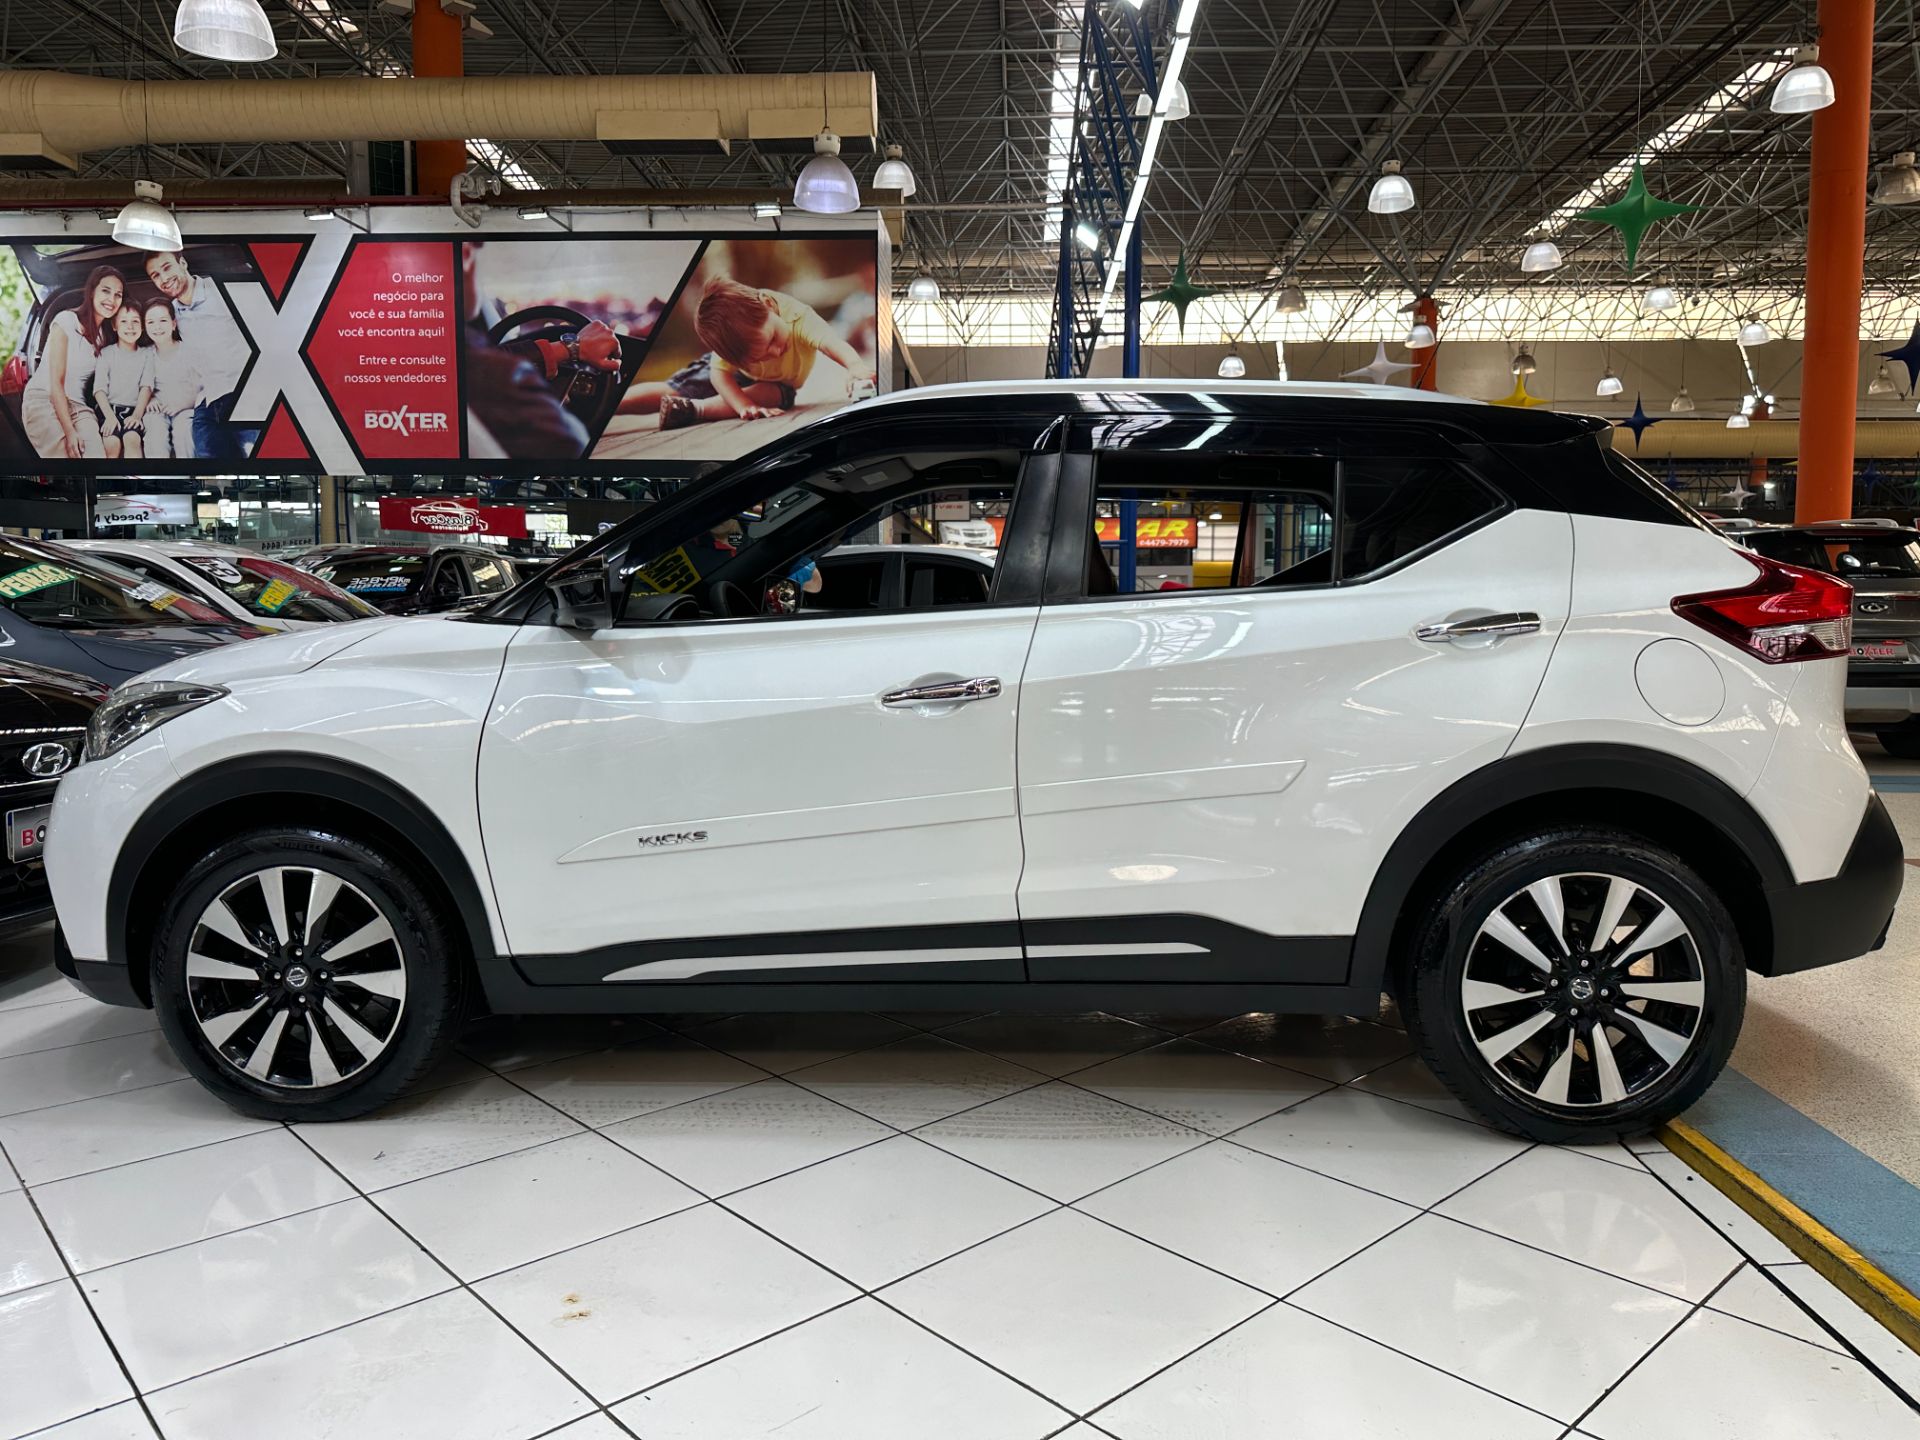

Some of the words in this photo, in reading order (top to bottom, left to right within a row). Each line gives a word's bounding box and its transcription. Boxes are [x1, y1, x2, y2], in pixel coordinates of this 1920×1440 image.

[392, 272, 402, 283] O
[405, 272, 444, 283] melhor
[373, 291, 418, 303] negócio
[420, 292, 444, 303] para
[349, 308, 376, 319] você
[378, 311, 385, 319] e
[387, 311, 406, 319] sua
[408, 308, 445, 319] família
[338, 326, 364, 337] você
[366, 327, 416, 337] encontra
[418, 326, 445, 339] aqui!
[359, 354, 388, 365] Entre
[390, 356, 397, 365] e
[399, 354, 447, 365] consulte
[344, 374, 381, 383] nossos
[384, 372, 447, 383] vendedores
[364, 405, 448, 436] BOXTER
[638, 831, 708, 848] KICKS
